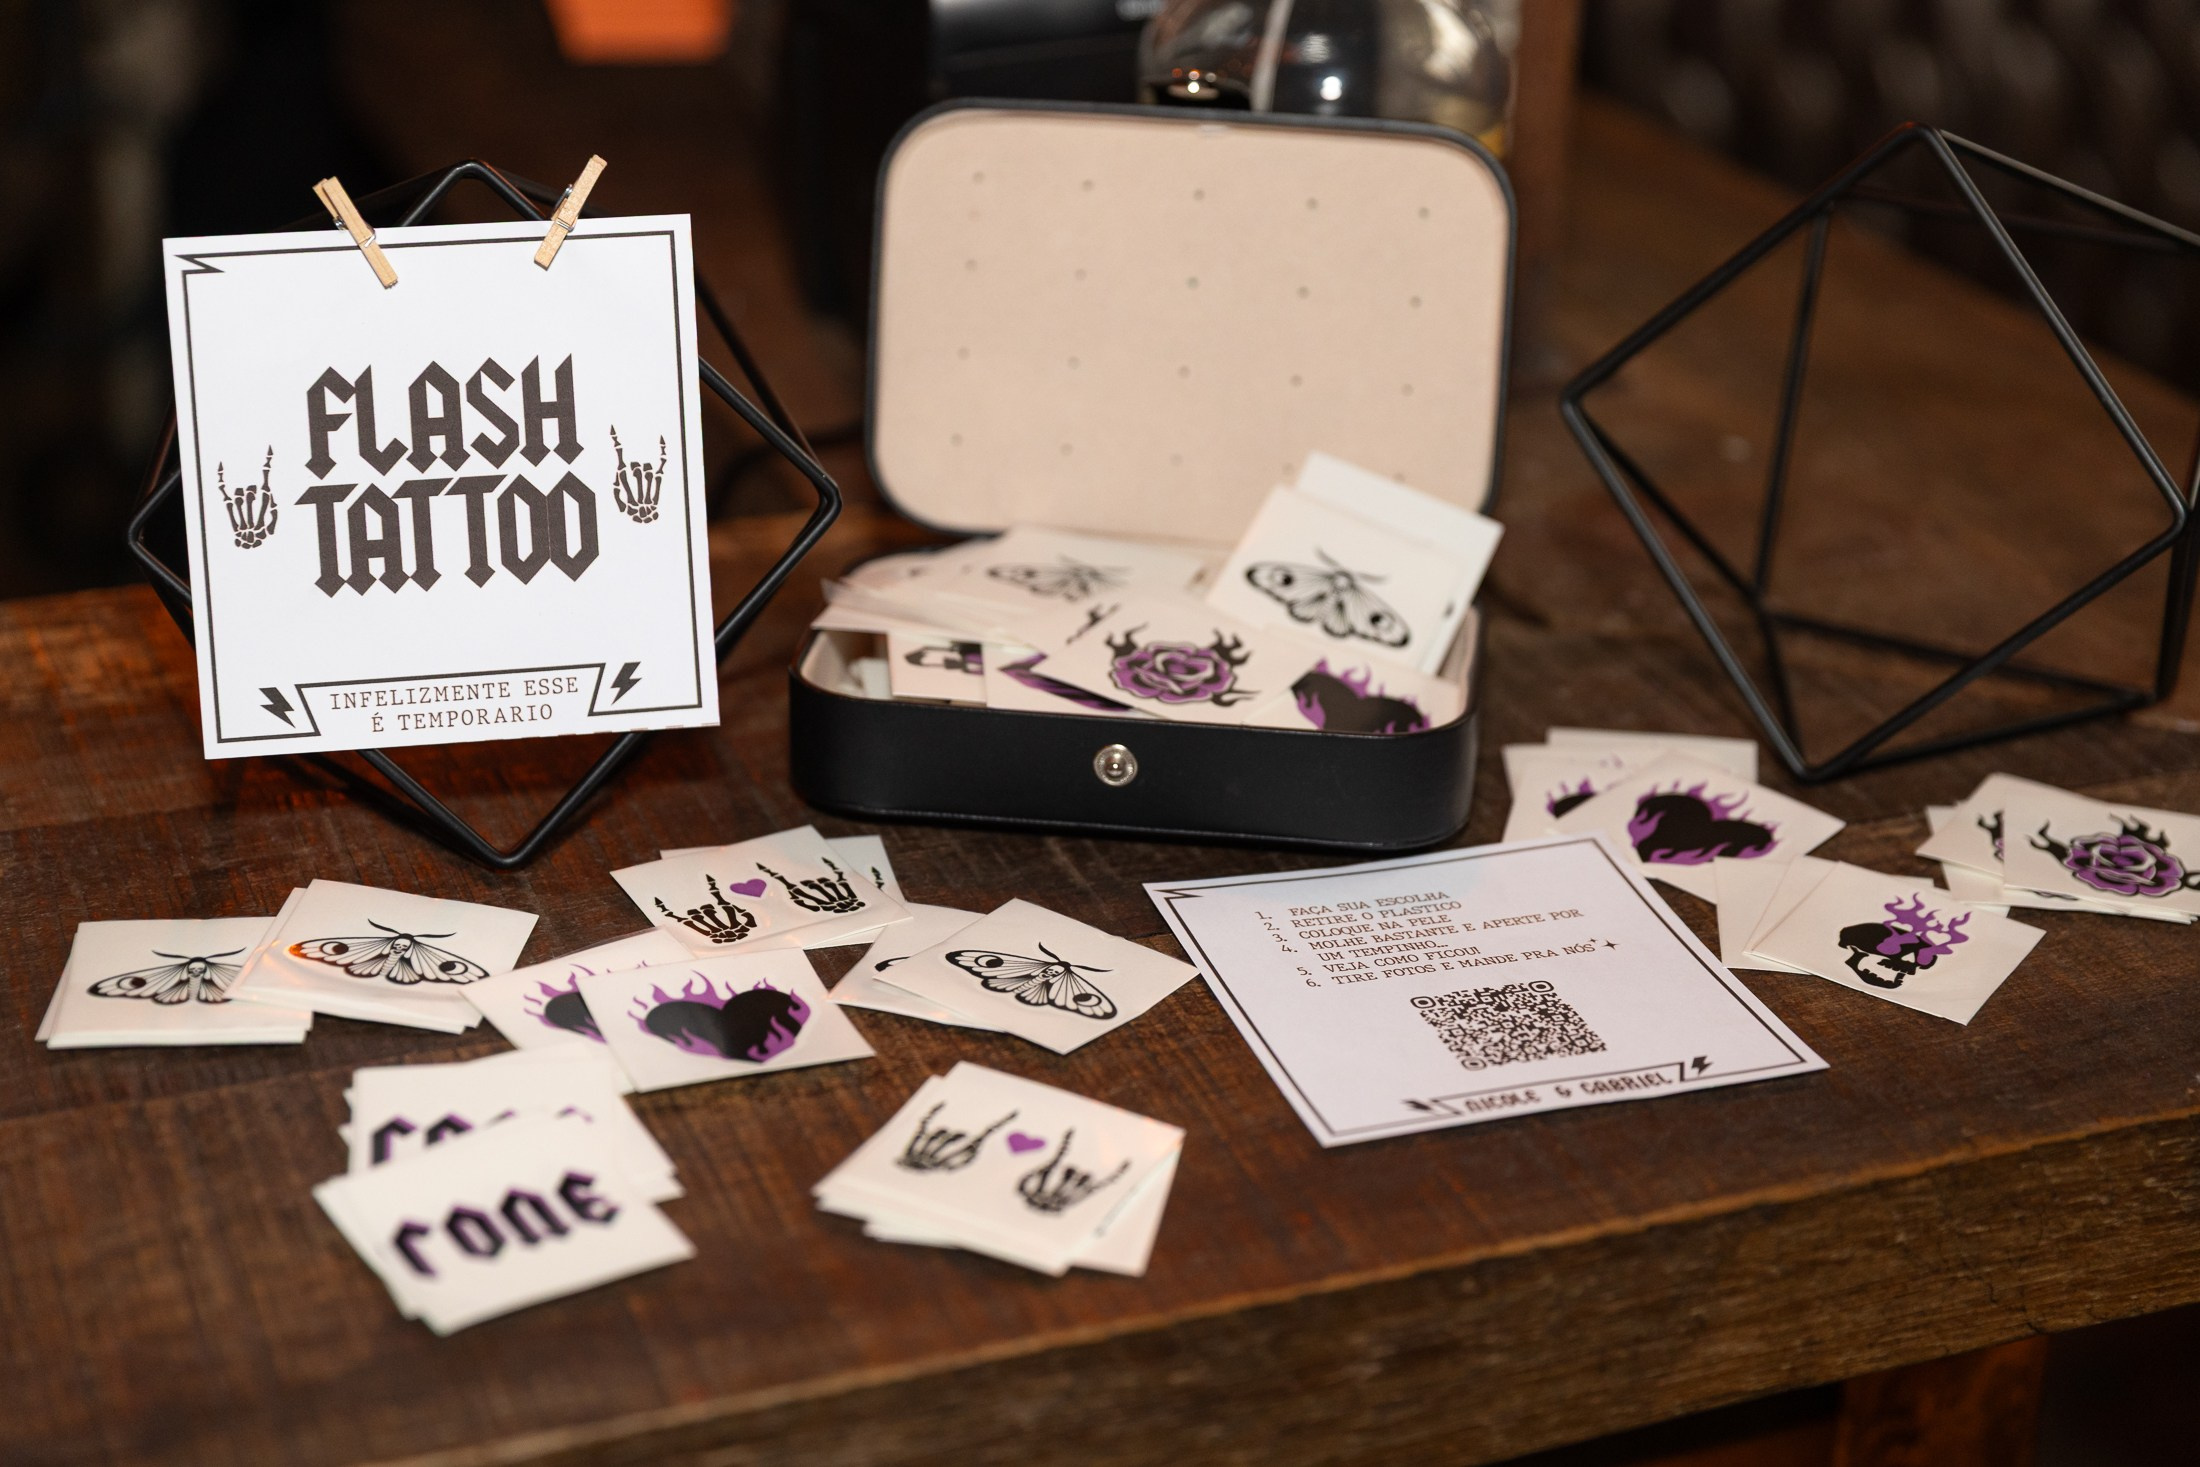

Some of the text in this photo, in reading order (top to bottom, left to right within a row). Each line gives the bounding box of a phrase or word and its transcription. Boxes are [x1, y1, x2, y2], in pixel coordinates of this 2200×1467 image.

[305, 353, 585, 480] FLASH
[294, 471, 599, 598] TATTOO
[330, 676, 579, 710] INFELIZMENTE ESSE
[371, 703, 553, 733] É TEMPORARIO
[1255, 891, 1450, 920] 1. FAÇA SUA ESCOLHA
[1264, 901, 1462, 931] 2. RETIRE O PLASTICO
[1272, 914, 1452, 942] 3. COLOQUE NA PELE
[1281, 908, 1585, 953] 4. MOLHE BASTANTE E APERTE POR
[1296, 946, 1481, 976] 5. VEJA COMO FICOU!
[1306, 943, 1596, 988] 6. TIRE FOTOS E MANDE PRA NÓS
[1317, 940, 1449, 962] UM TEMPINHO...
[1580, 1071, 1673, 1096] GABRIEL
